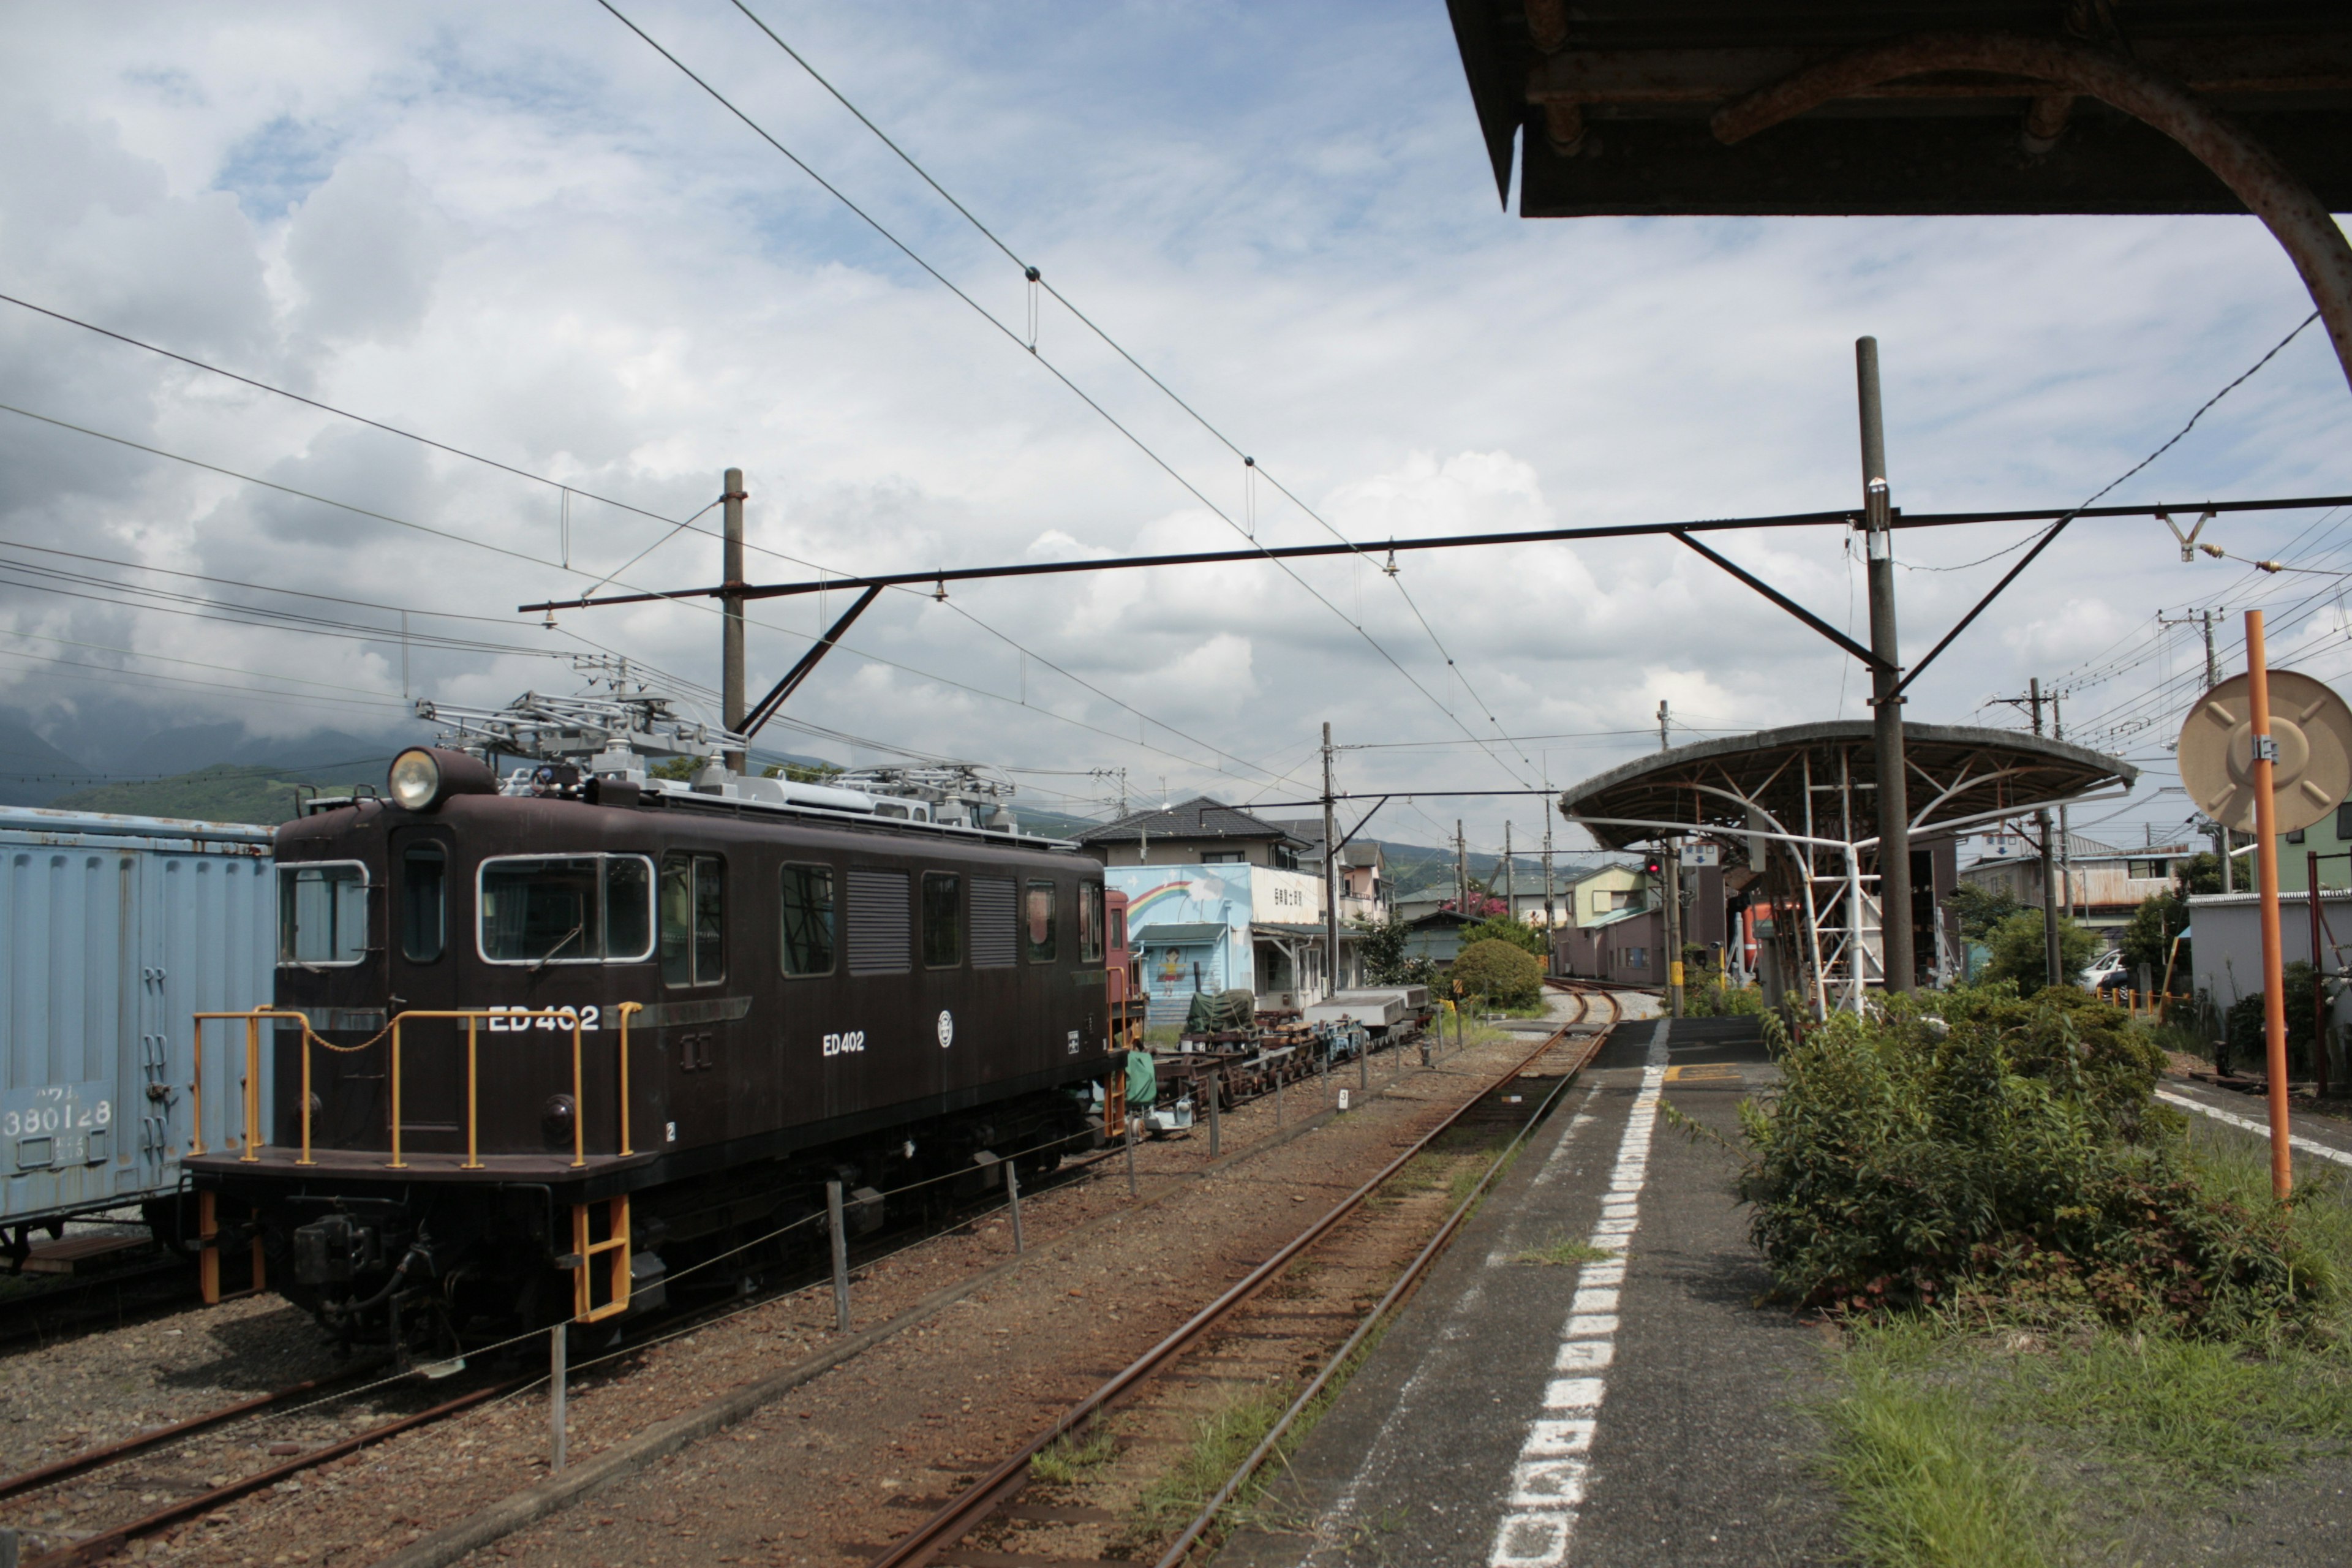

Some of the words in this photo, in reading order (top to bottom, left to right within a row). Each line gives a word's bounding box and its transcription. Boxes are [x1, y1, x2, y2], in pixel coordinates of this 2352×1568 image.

[488, 1005, 599, 1031] ED402
[823, 1030, 864, 1057] ED402
[4, 1100, 111, 1136] 380128
[667, 1123, 674, 1140] 2
